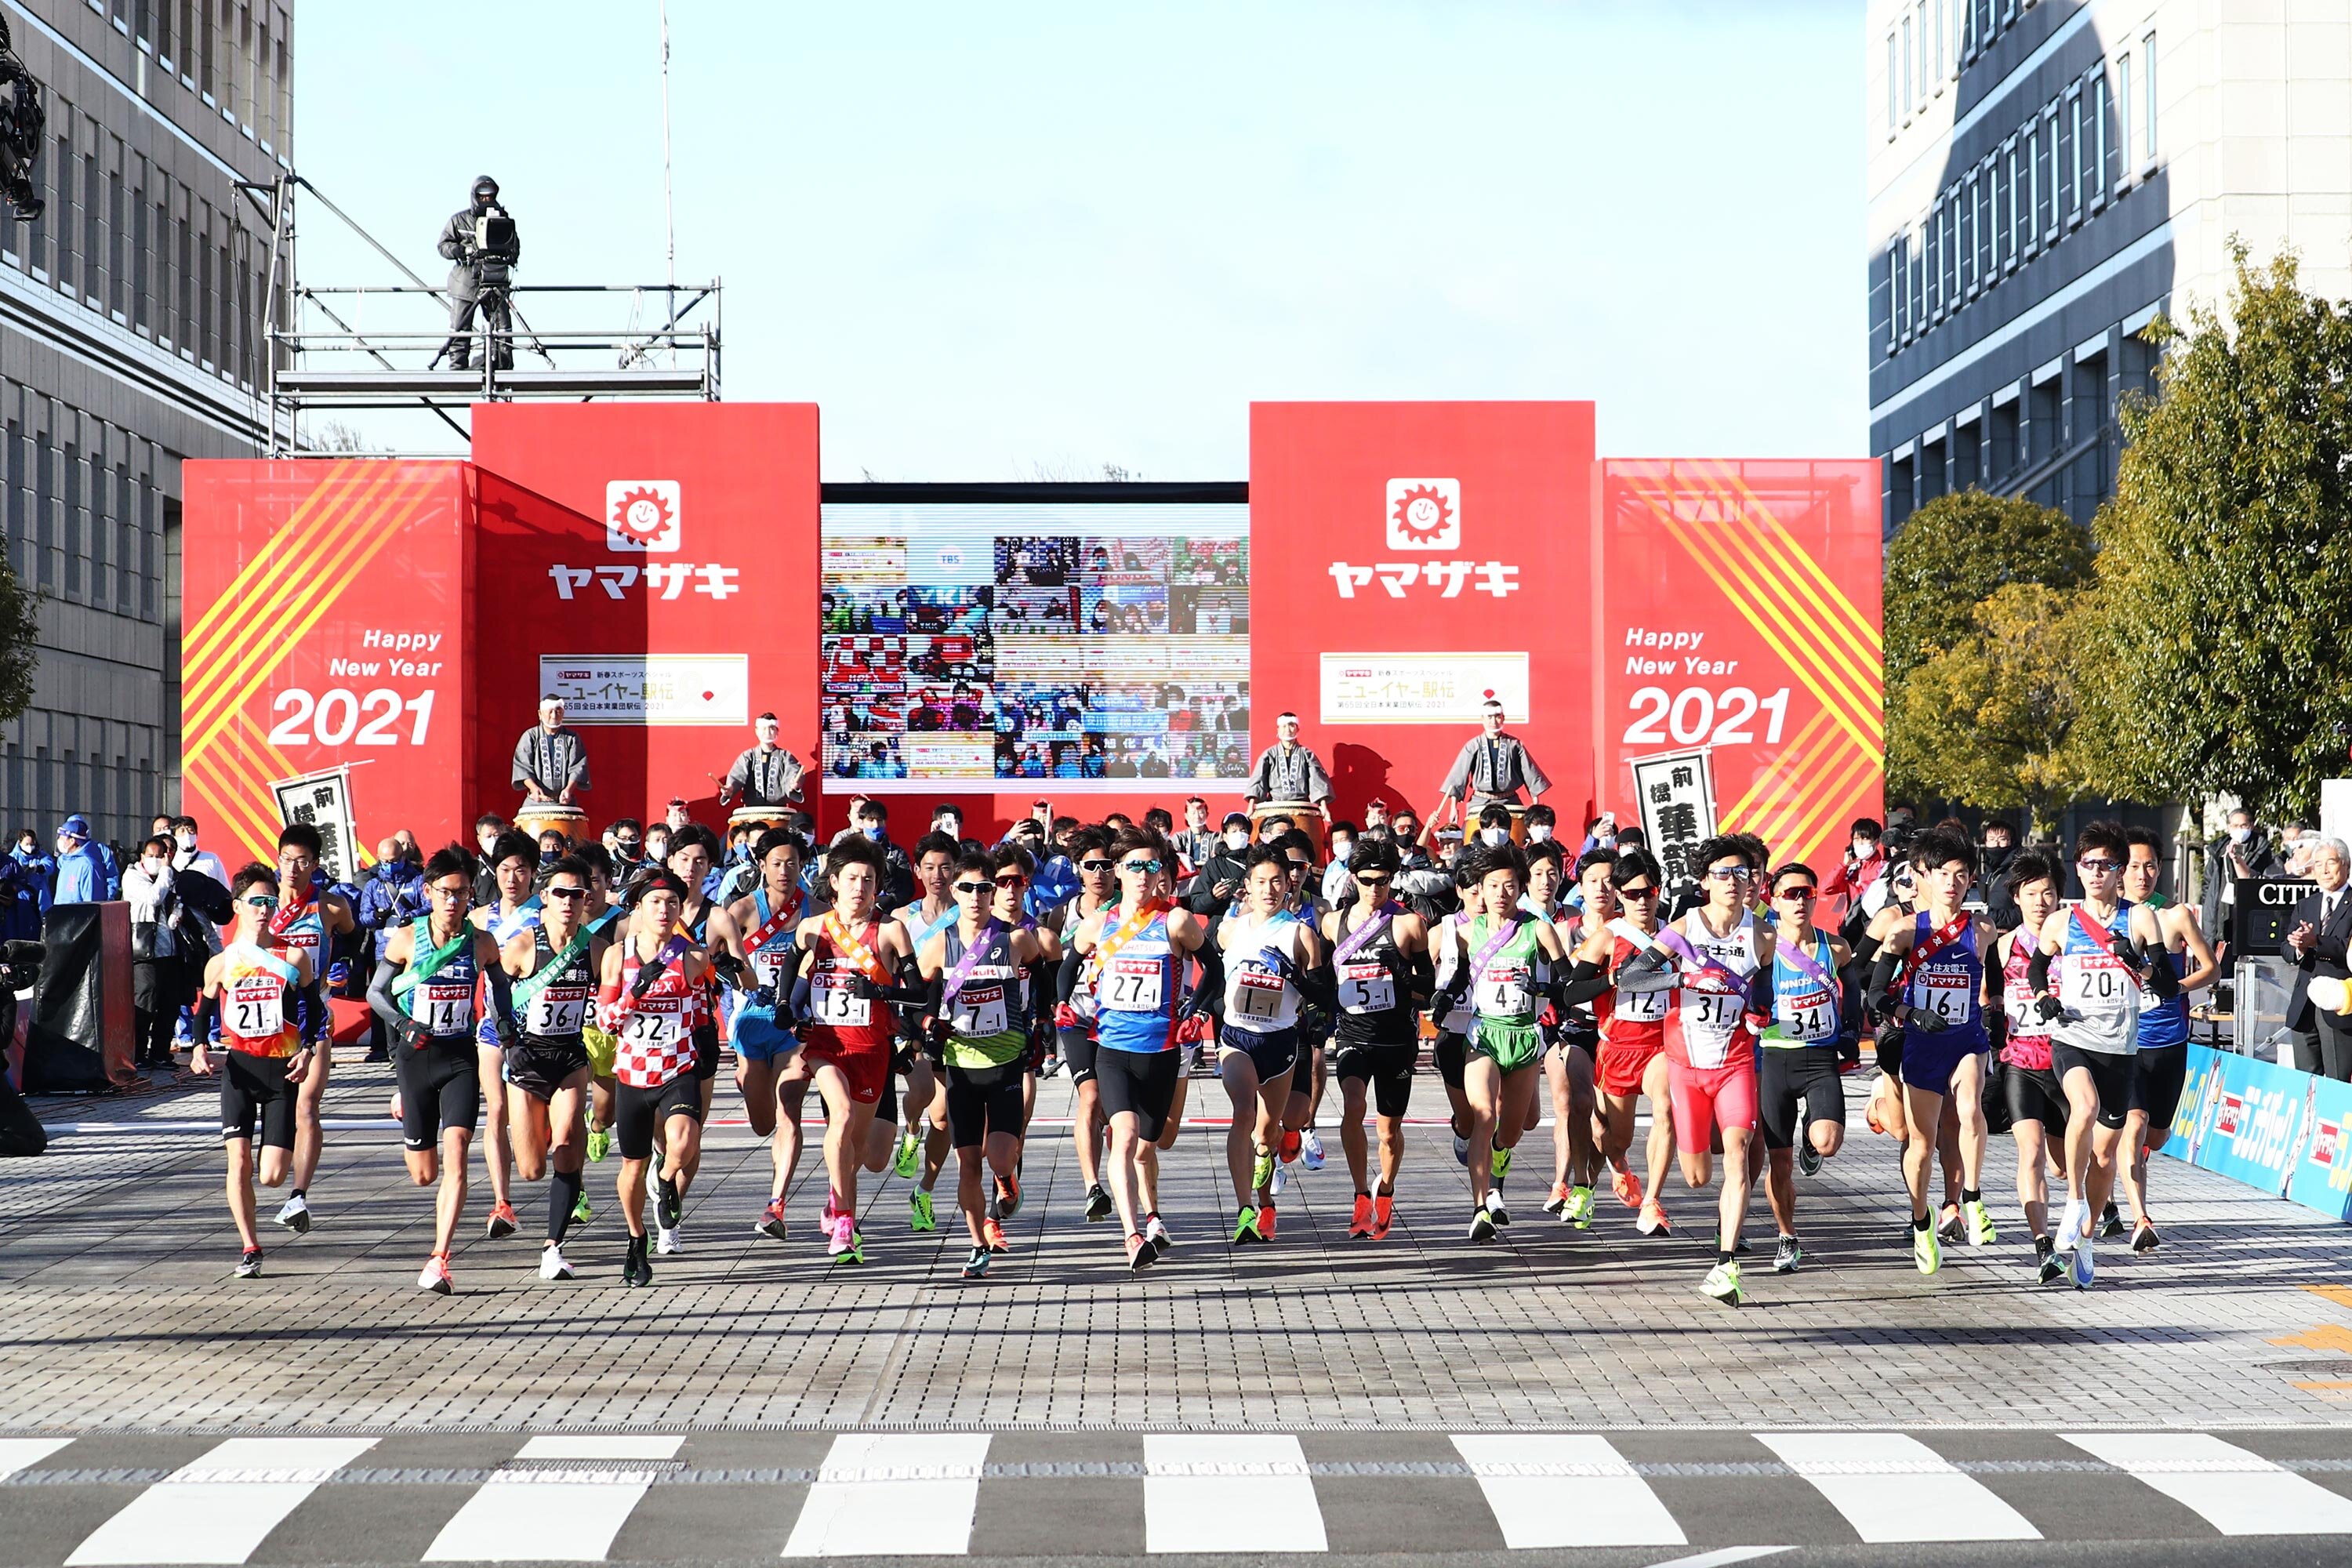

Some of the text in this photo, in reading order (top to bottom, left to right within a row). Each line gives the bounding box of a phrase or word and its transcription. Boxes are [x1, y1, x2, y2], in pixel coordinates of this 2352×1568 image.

[942, 555, 960, 564] TBS
[549, 564, 739, 600] ヤマザキ
[1329, 561, 1519, 597] ヤマザキ
[363, 630, 441, 652] Happy
[1625, 628, 1704, 650] Happy
[329, 658, 442, 677] New Year
[1625, 656, 1738, 675] New Year
[557, 682, 673, 700] ニューイヤー駅伝
[1337, 681, 1455, 699] ニューイヤー駅伝
[267, 688, 435, 746] 2021
[1622, 686, 1790, 744] 2021
[1650, 766, 1693, 804] 前橋
[1116, 963, 1159, 973] ヤマザキ
[1929, 976, 1966, 985] ヤマザキ
[1933, 963, 1968, 973] 住友電工
[431, 989, 468, 997] ヤマザキ
[1113, 975, 1156, 1003] 27-1
[1243, 975, 1281, 988] ヤマザキ
[1356, 980, 1388, 1006] 5-1
[2081, 972, 2124, 999] 20-1
[237, 989, 277, 1000] ヤマザキ
[546, 990, 583, 1000] ヤマザキ
[825, 990, 865, 1017] 13-1
[962, 990, 1000, 1002] ヤマザキ
[1245, 988, 1274, 1017] 1-1
[1495, 984, 1526, 1008] 4-1
[1632, 992, 1667, 1014] 12-1
[1792, 993, 1828, 1007] ヤマザキ
[1926, 989, 1965, 1018] 16-1
[238, 1003, 278, 1029] 21-1
[430, 1002, 466, 1028] 14-1
[539, 1003, 579, 1028] 36-1
[967, 1005, 1000, 1030] 7-1
[1697, 996, 1737, 1023] 31-1
[1791, 1008, 1832, 1036] 34-1
[633, 1013, 676, 1040] 32-1
[2232, 1085, 2298, 1171] ランチパック
